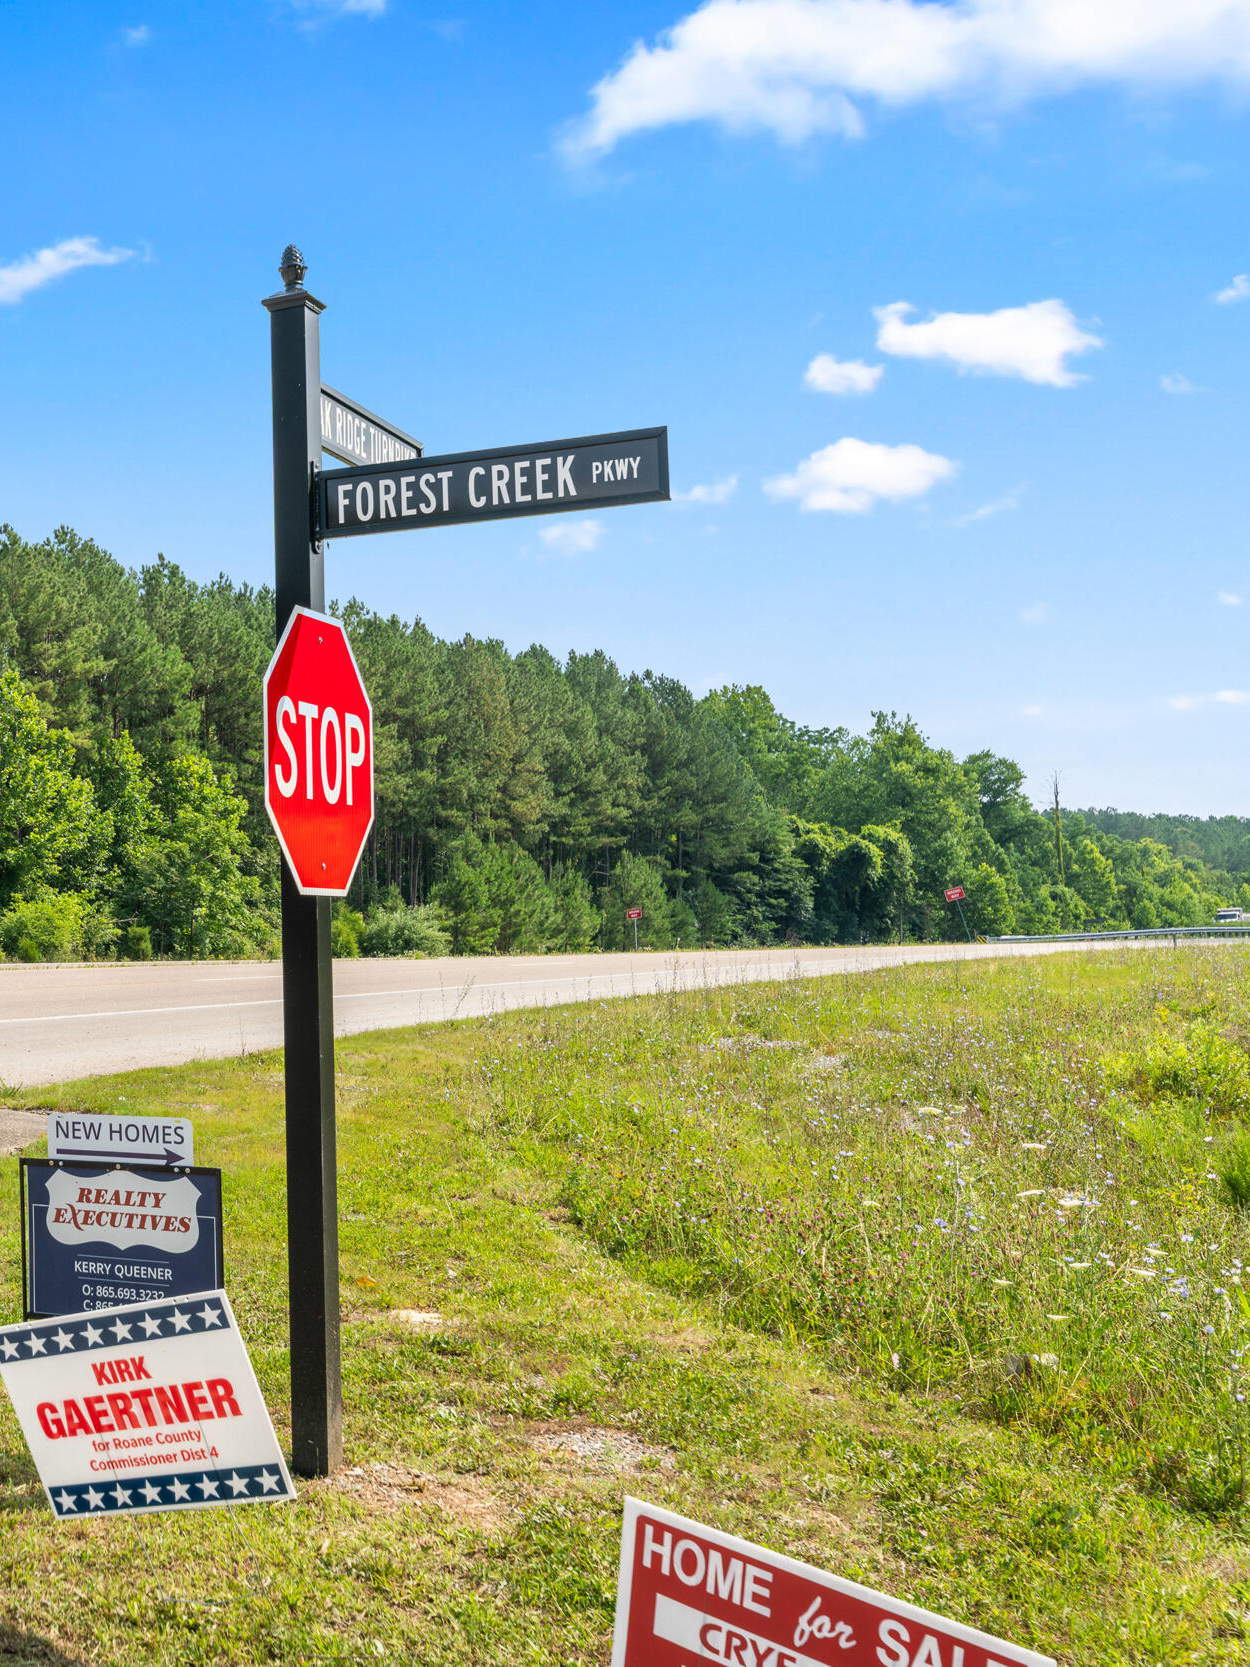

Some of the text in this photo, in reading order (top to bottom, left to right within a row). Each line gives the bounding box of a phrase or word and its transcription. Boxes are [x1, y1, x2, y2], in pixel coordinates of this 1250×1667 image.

[335, 407, 367, 458] RIDGE
[337, 455, 641, 524] FOREST CREEK PKWY
[274, 695, 365, 806] STOP
[56, 1120, 185, 1145] NEW HOMES
[76, 1187, 166, 1209] REALTY
[52, 1204, 192, 1233] EXECUTIVES
[74, 1260, 173, 1281] KERRY QUEENER
[82, 1284, 165, 1301] O: 865.693.3232
[91, 1356, 152, 1386] KIRK
[36, 1378, 243, 1440] GAERTNER
[91, 1428, 202, 1452] for Roane County
[90, 1446, 219, 1472] Commissioner Dist 4
[642, 1523, 773, 1618] HOME
[793, 1596, 857, 1650] for
